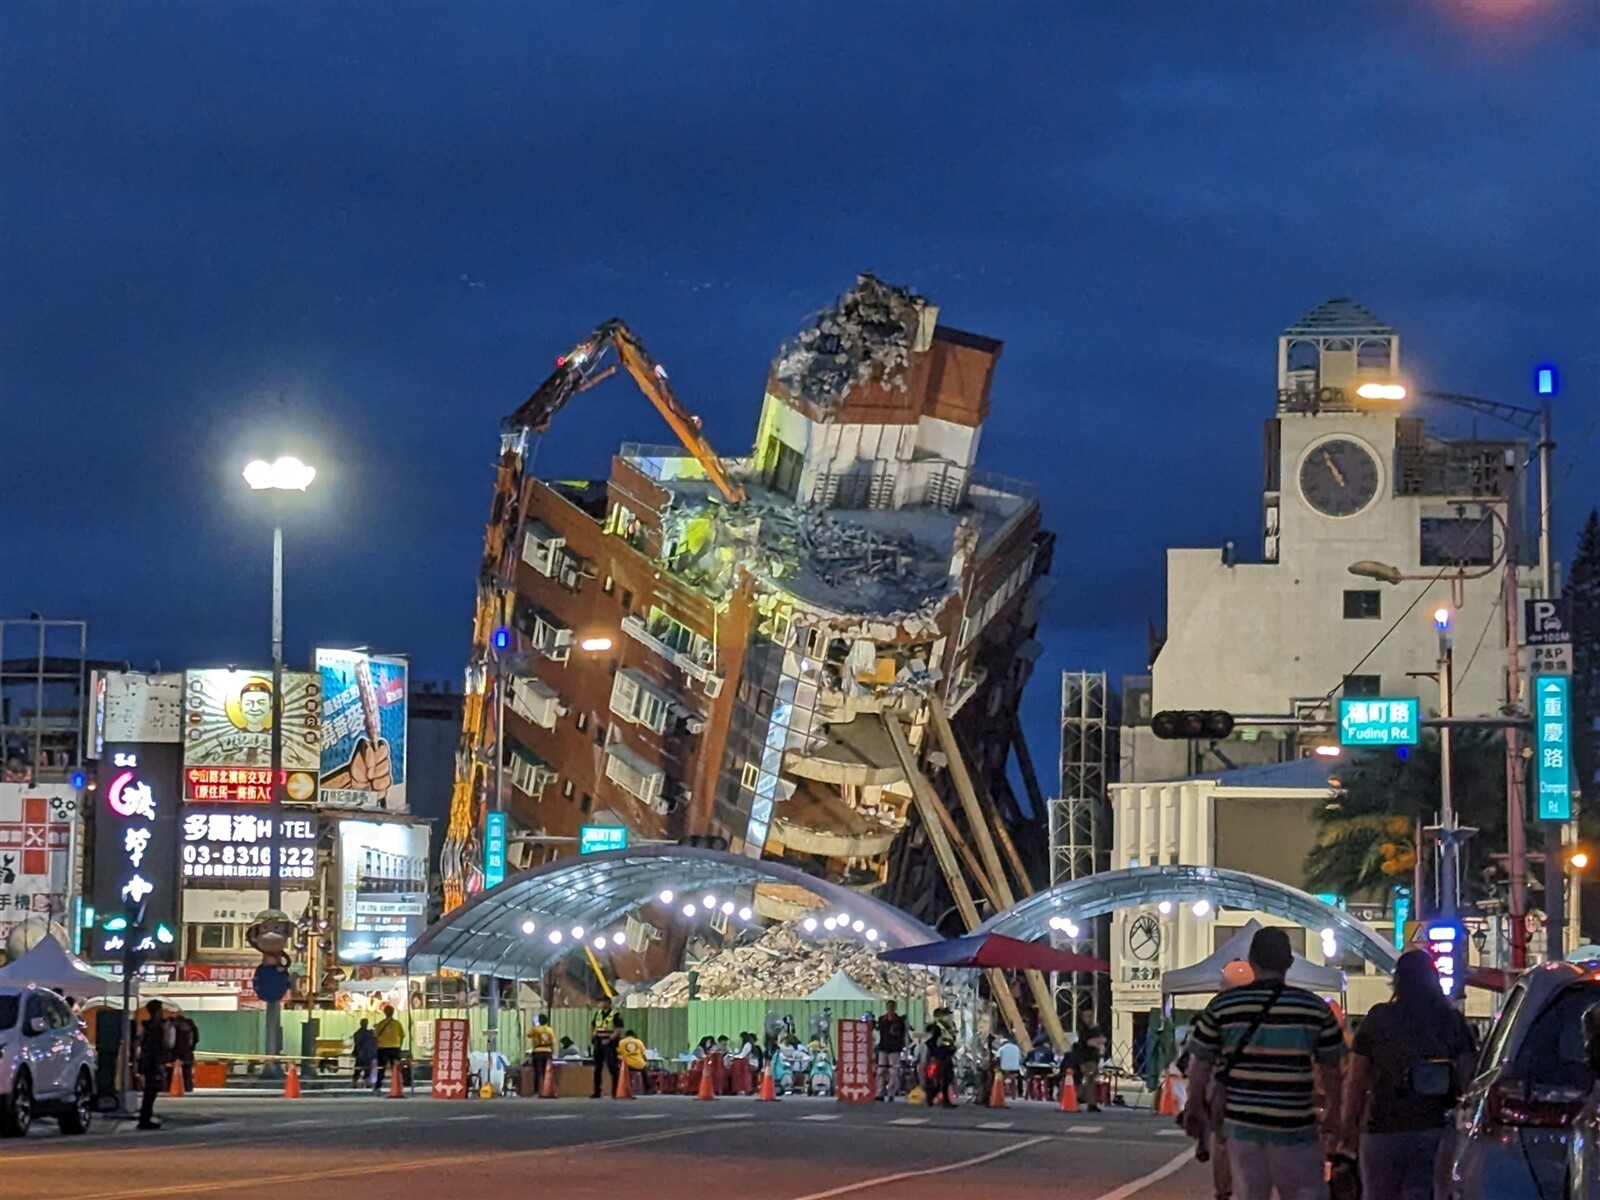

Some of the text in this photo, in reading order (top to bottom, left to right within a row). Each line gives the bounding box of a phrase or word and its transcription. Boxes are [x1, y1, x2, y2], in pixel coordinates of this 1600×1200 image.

[1348, 701, 1409, 723] 福町路
[1348, 727, 1389, 743] Fuding
[1543, 697, 1563, 768] 重慶路
